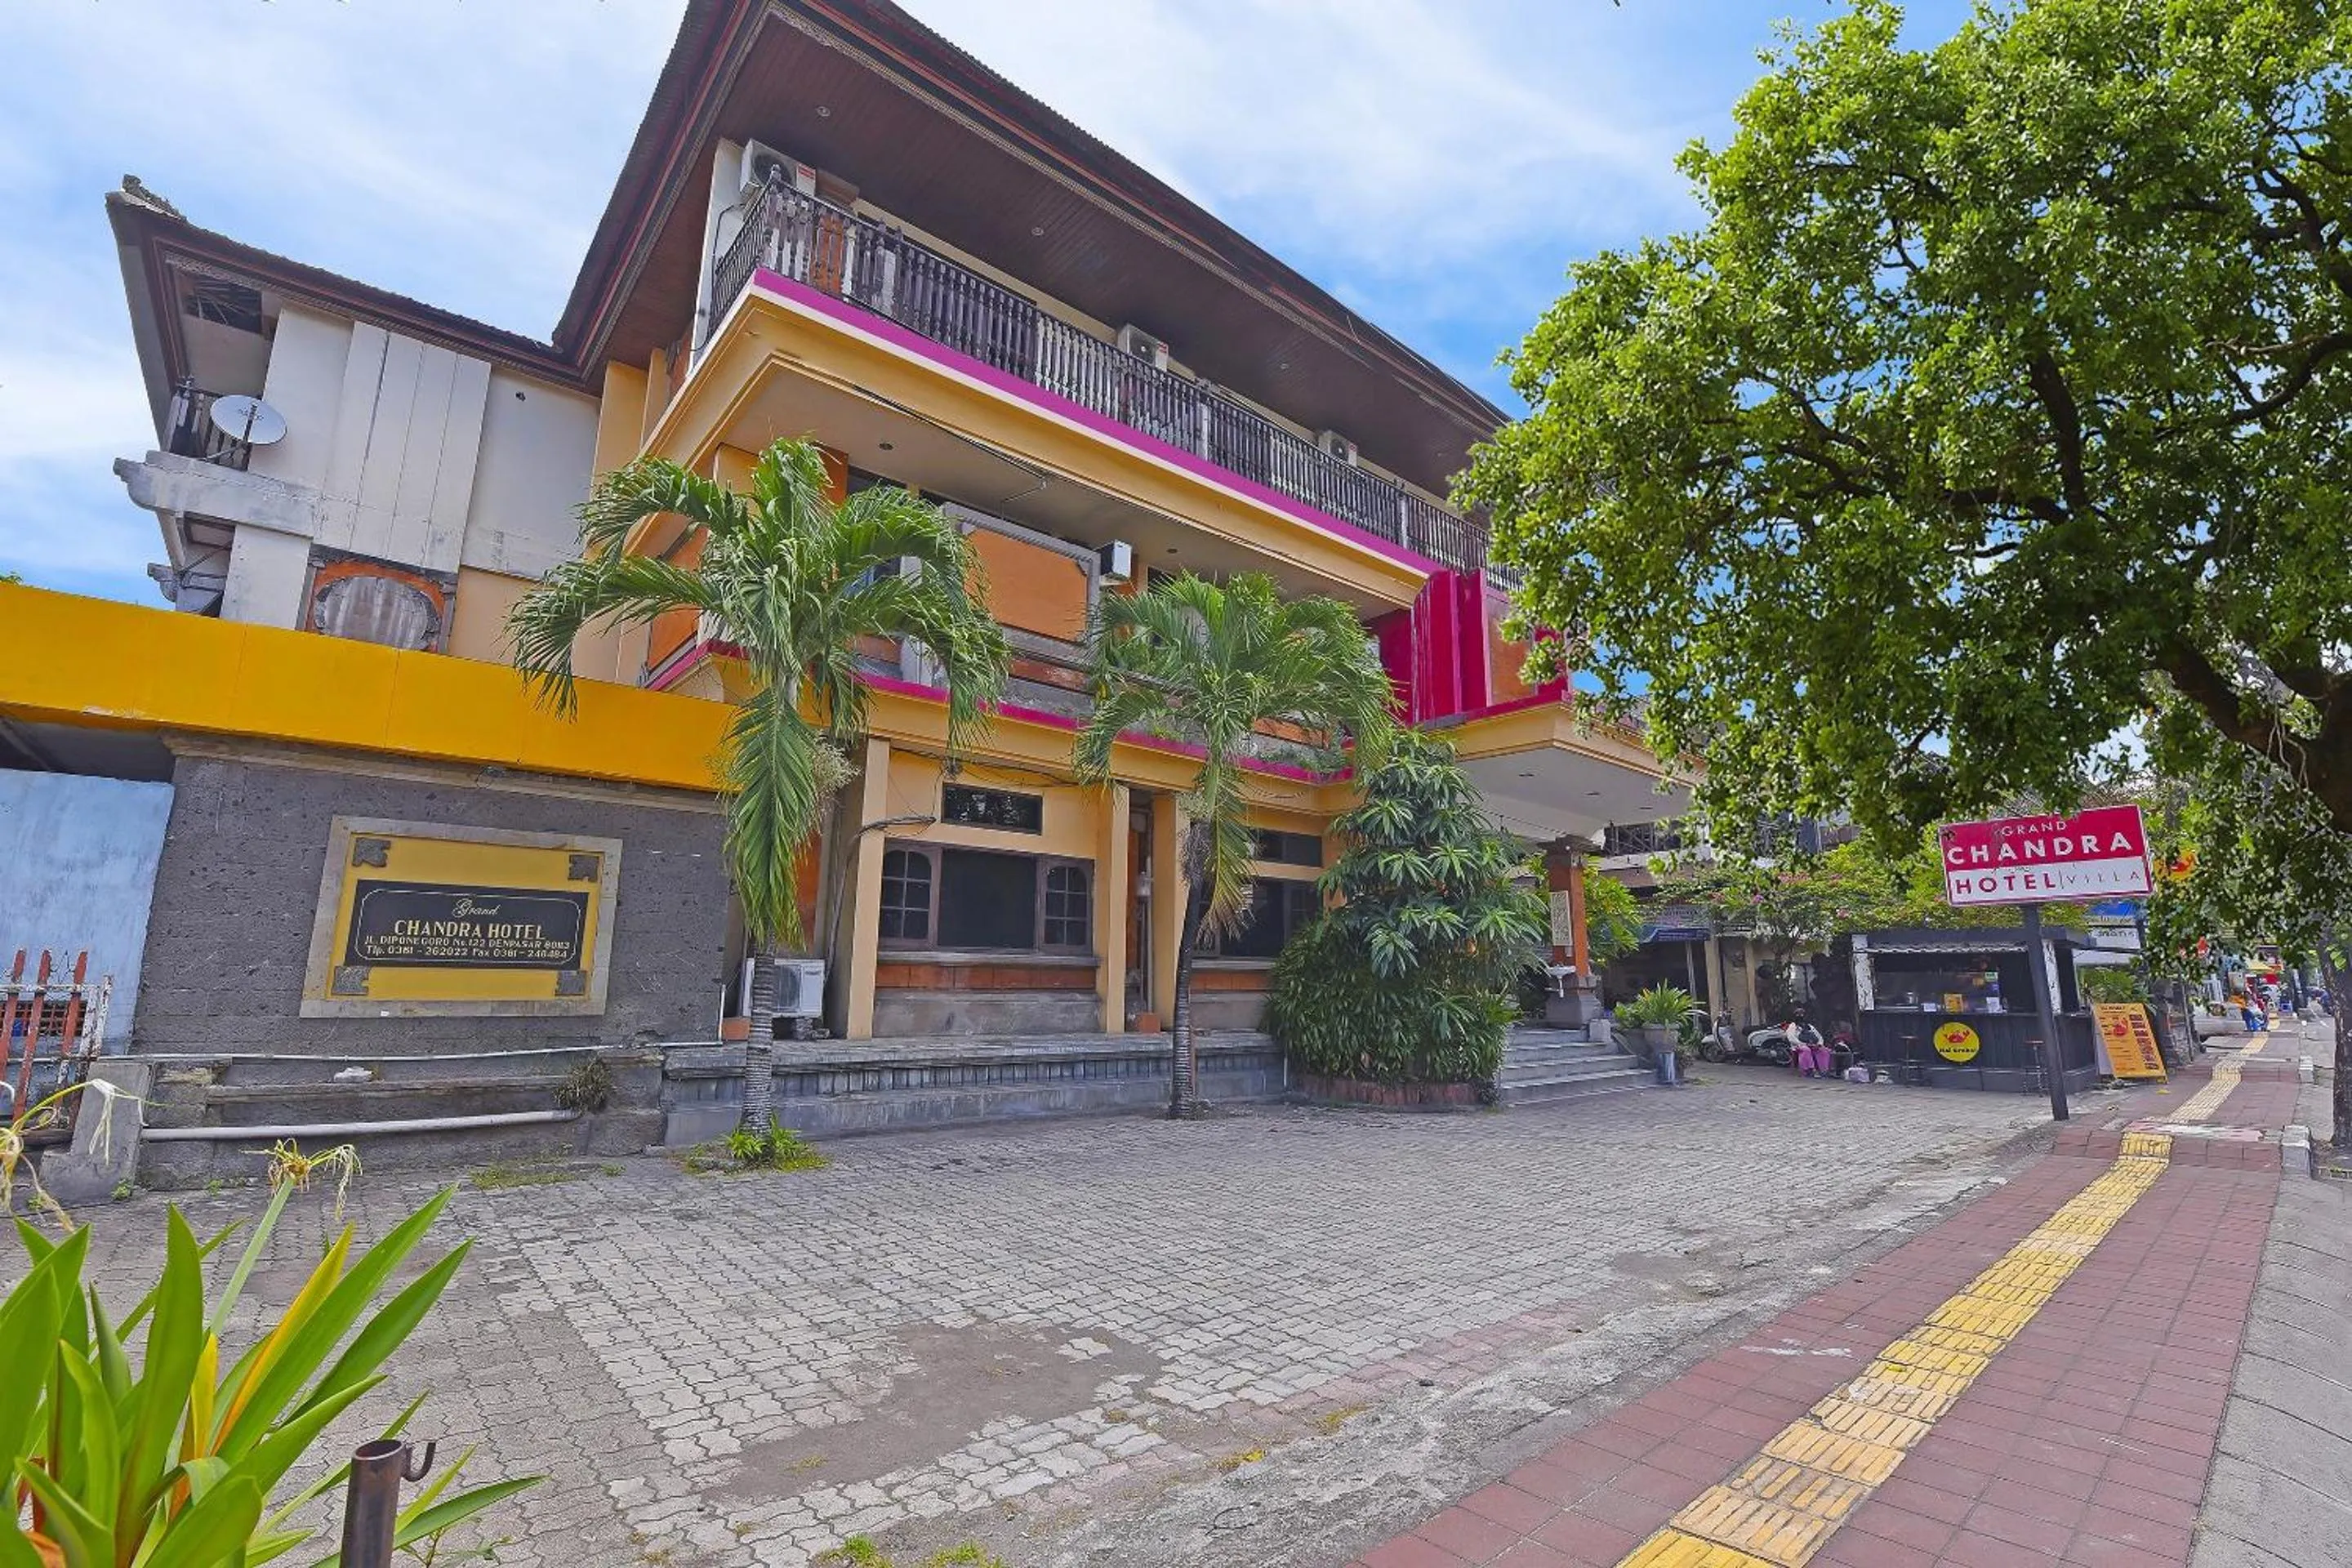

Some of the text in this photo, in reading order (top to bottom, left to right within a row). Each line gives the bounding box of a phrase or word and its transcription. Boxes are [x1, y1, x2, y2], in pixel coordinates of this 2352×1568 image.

[2001, 820, 2068, 837] GRAND
[1946, 831, 2133, 865] CHANDRA
[1955, 872, 2056, 895] HOTEL
[452, 898, 501, 919] Grand
[394, 919, 546, 940] CHANDRA HOTEL
[473, 948, 490, 957] Fax
[488, 938, 542, 950] DENPASAR
